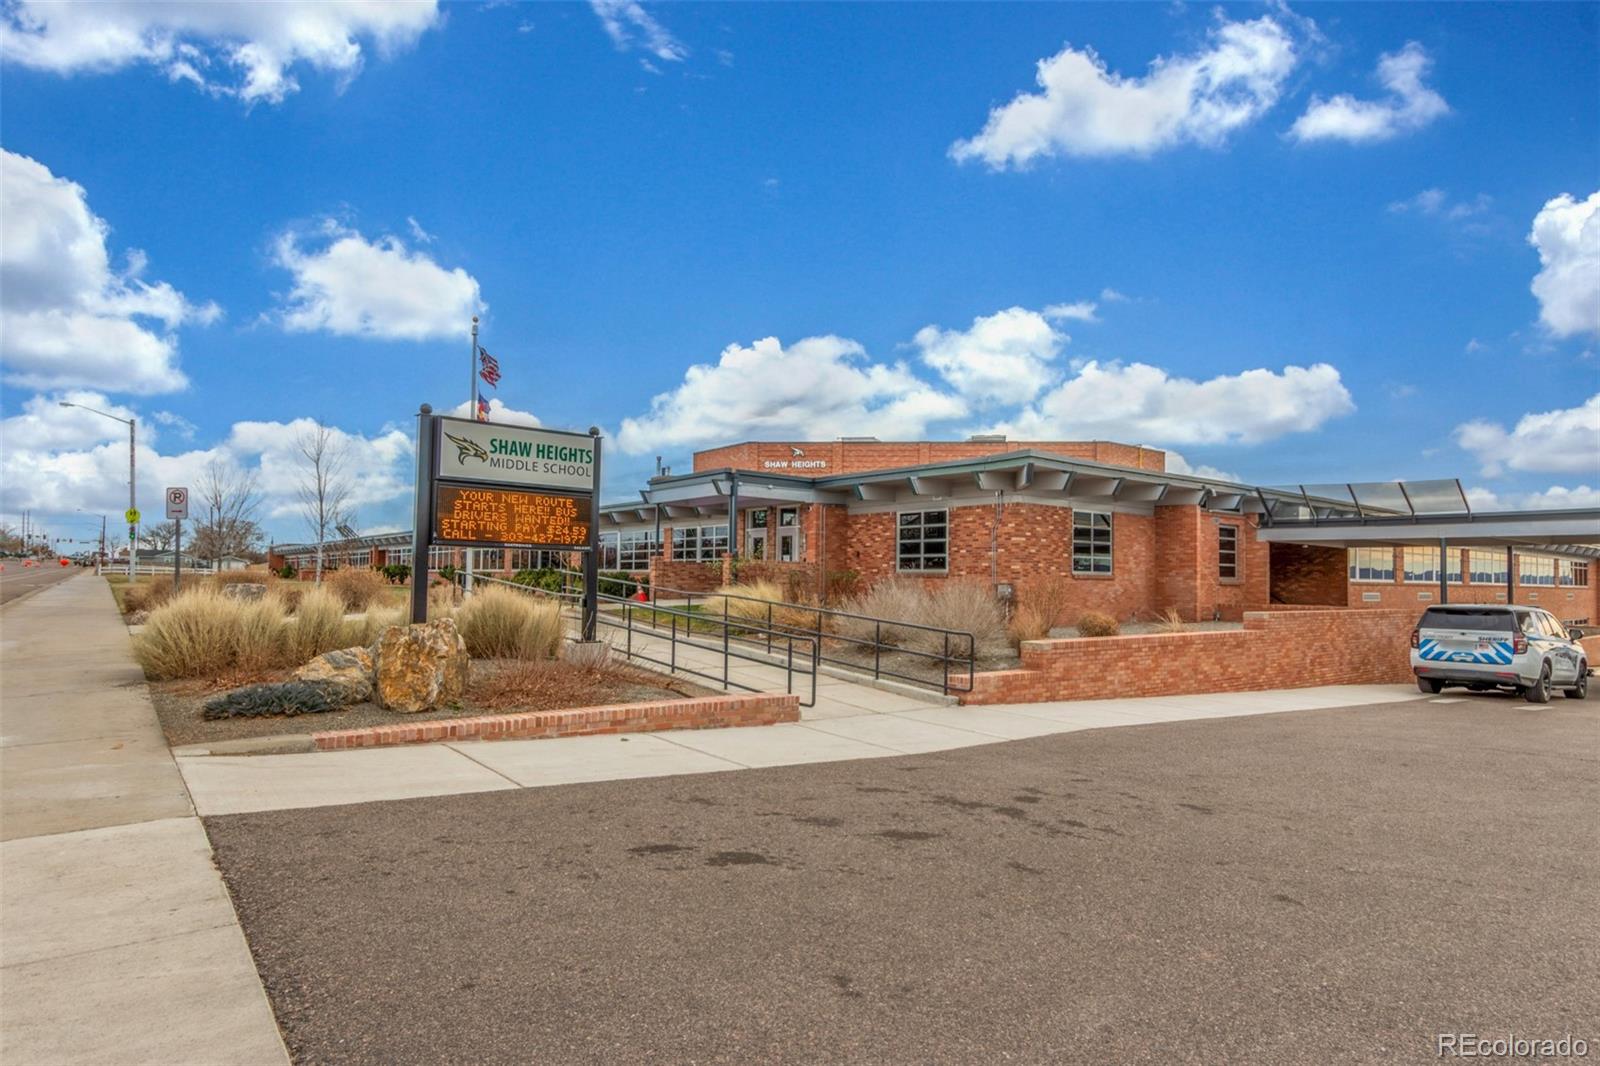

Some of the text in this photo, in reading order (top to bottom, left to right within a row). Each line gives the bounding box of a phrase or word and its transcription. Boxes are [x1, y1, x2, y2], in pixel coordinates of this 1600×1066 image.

[489, 438, 593, 464] SHAW HEIGHTS
[489, 457, 591, 478] MIDDLE SCHOOL
[764, 460, 826, 469] SHAW HEIGHTS
[460, 490, 574, 508] YOUR NEW ROUTE
[453, 509, 508, 522] DRIVERS
[454, 499, 506, 512] STARTS
[555, 507, 577, 518] BUS
[441, 518, 587, 536] STARTING PAY $24.59
[443, 528, 477, 540] CALL
